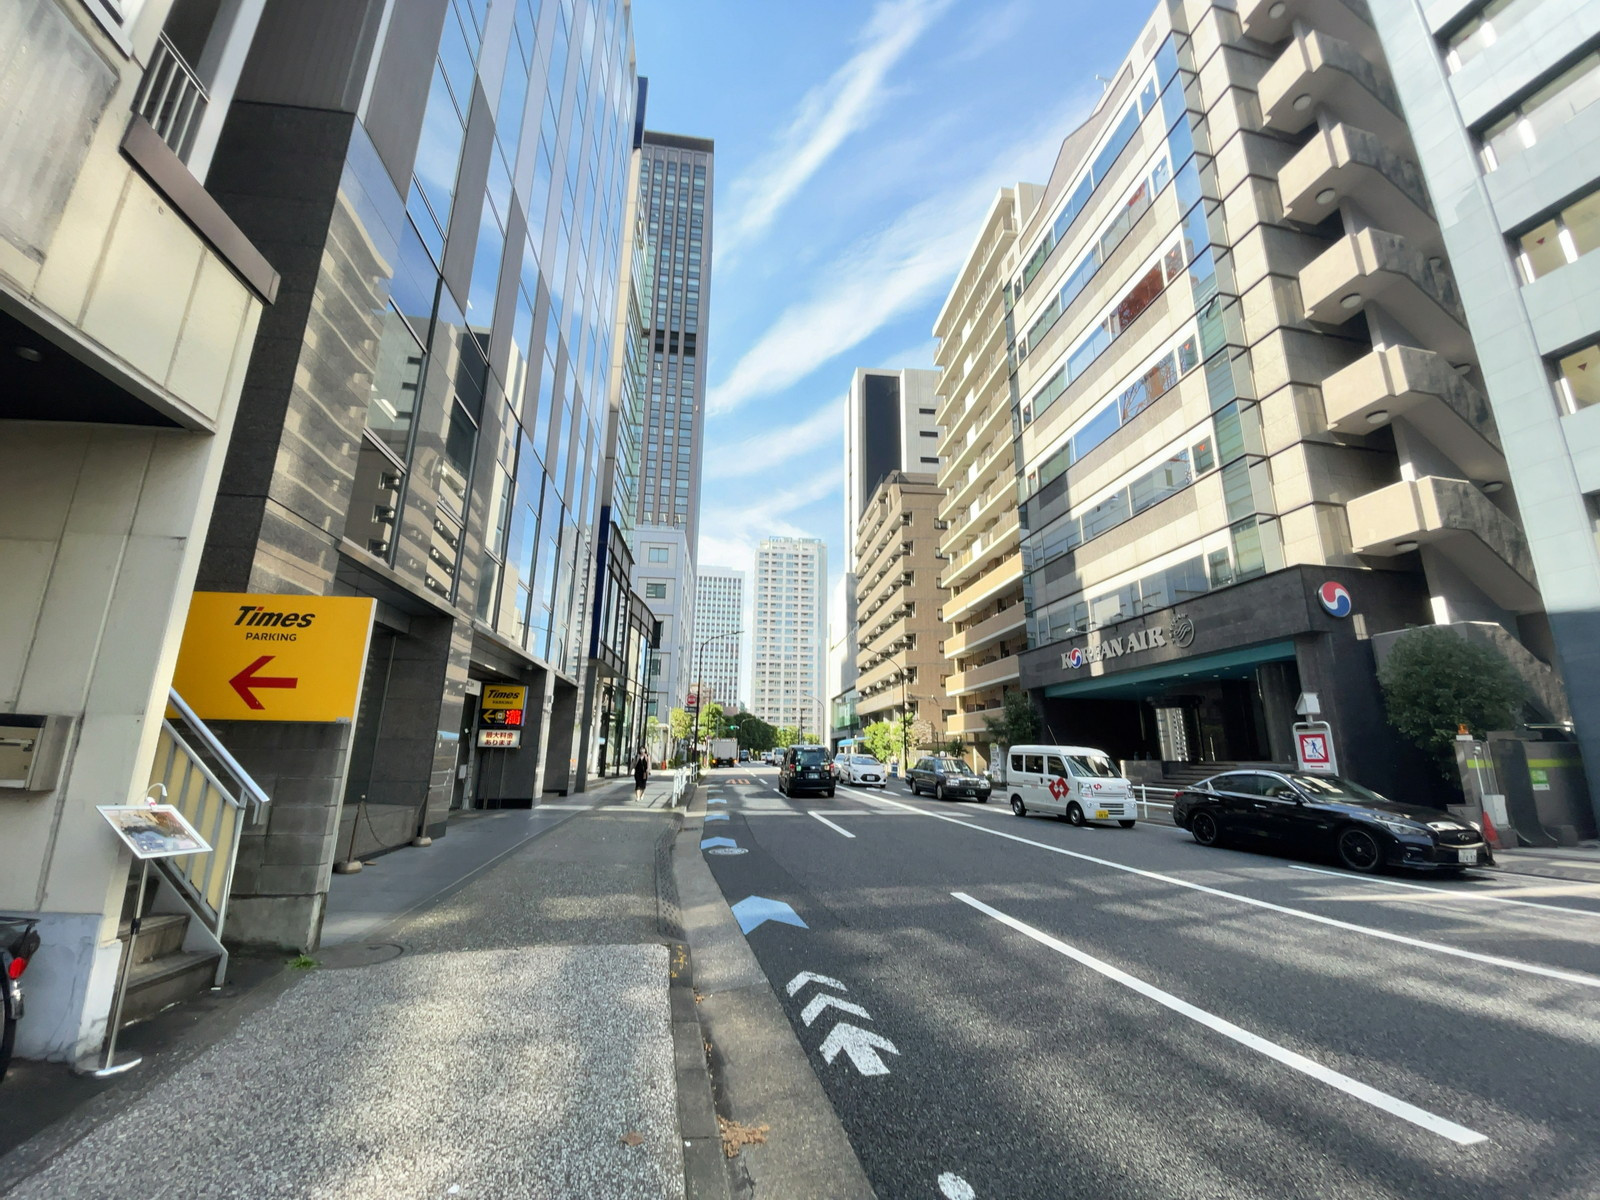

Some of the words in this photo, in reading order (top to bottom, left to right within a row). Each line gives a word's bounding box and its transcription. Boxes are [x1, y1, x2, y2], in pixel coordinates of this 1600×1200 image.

[234, 605, 316, 628] Times
[245, 631, 297, 642] PARKING
[1060, 637, 1124, 670] KOREAN
[1126, 626, 1167, 654] AIR
[487, 689, 520, 699] Times
